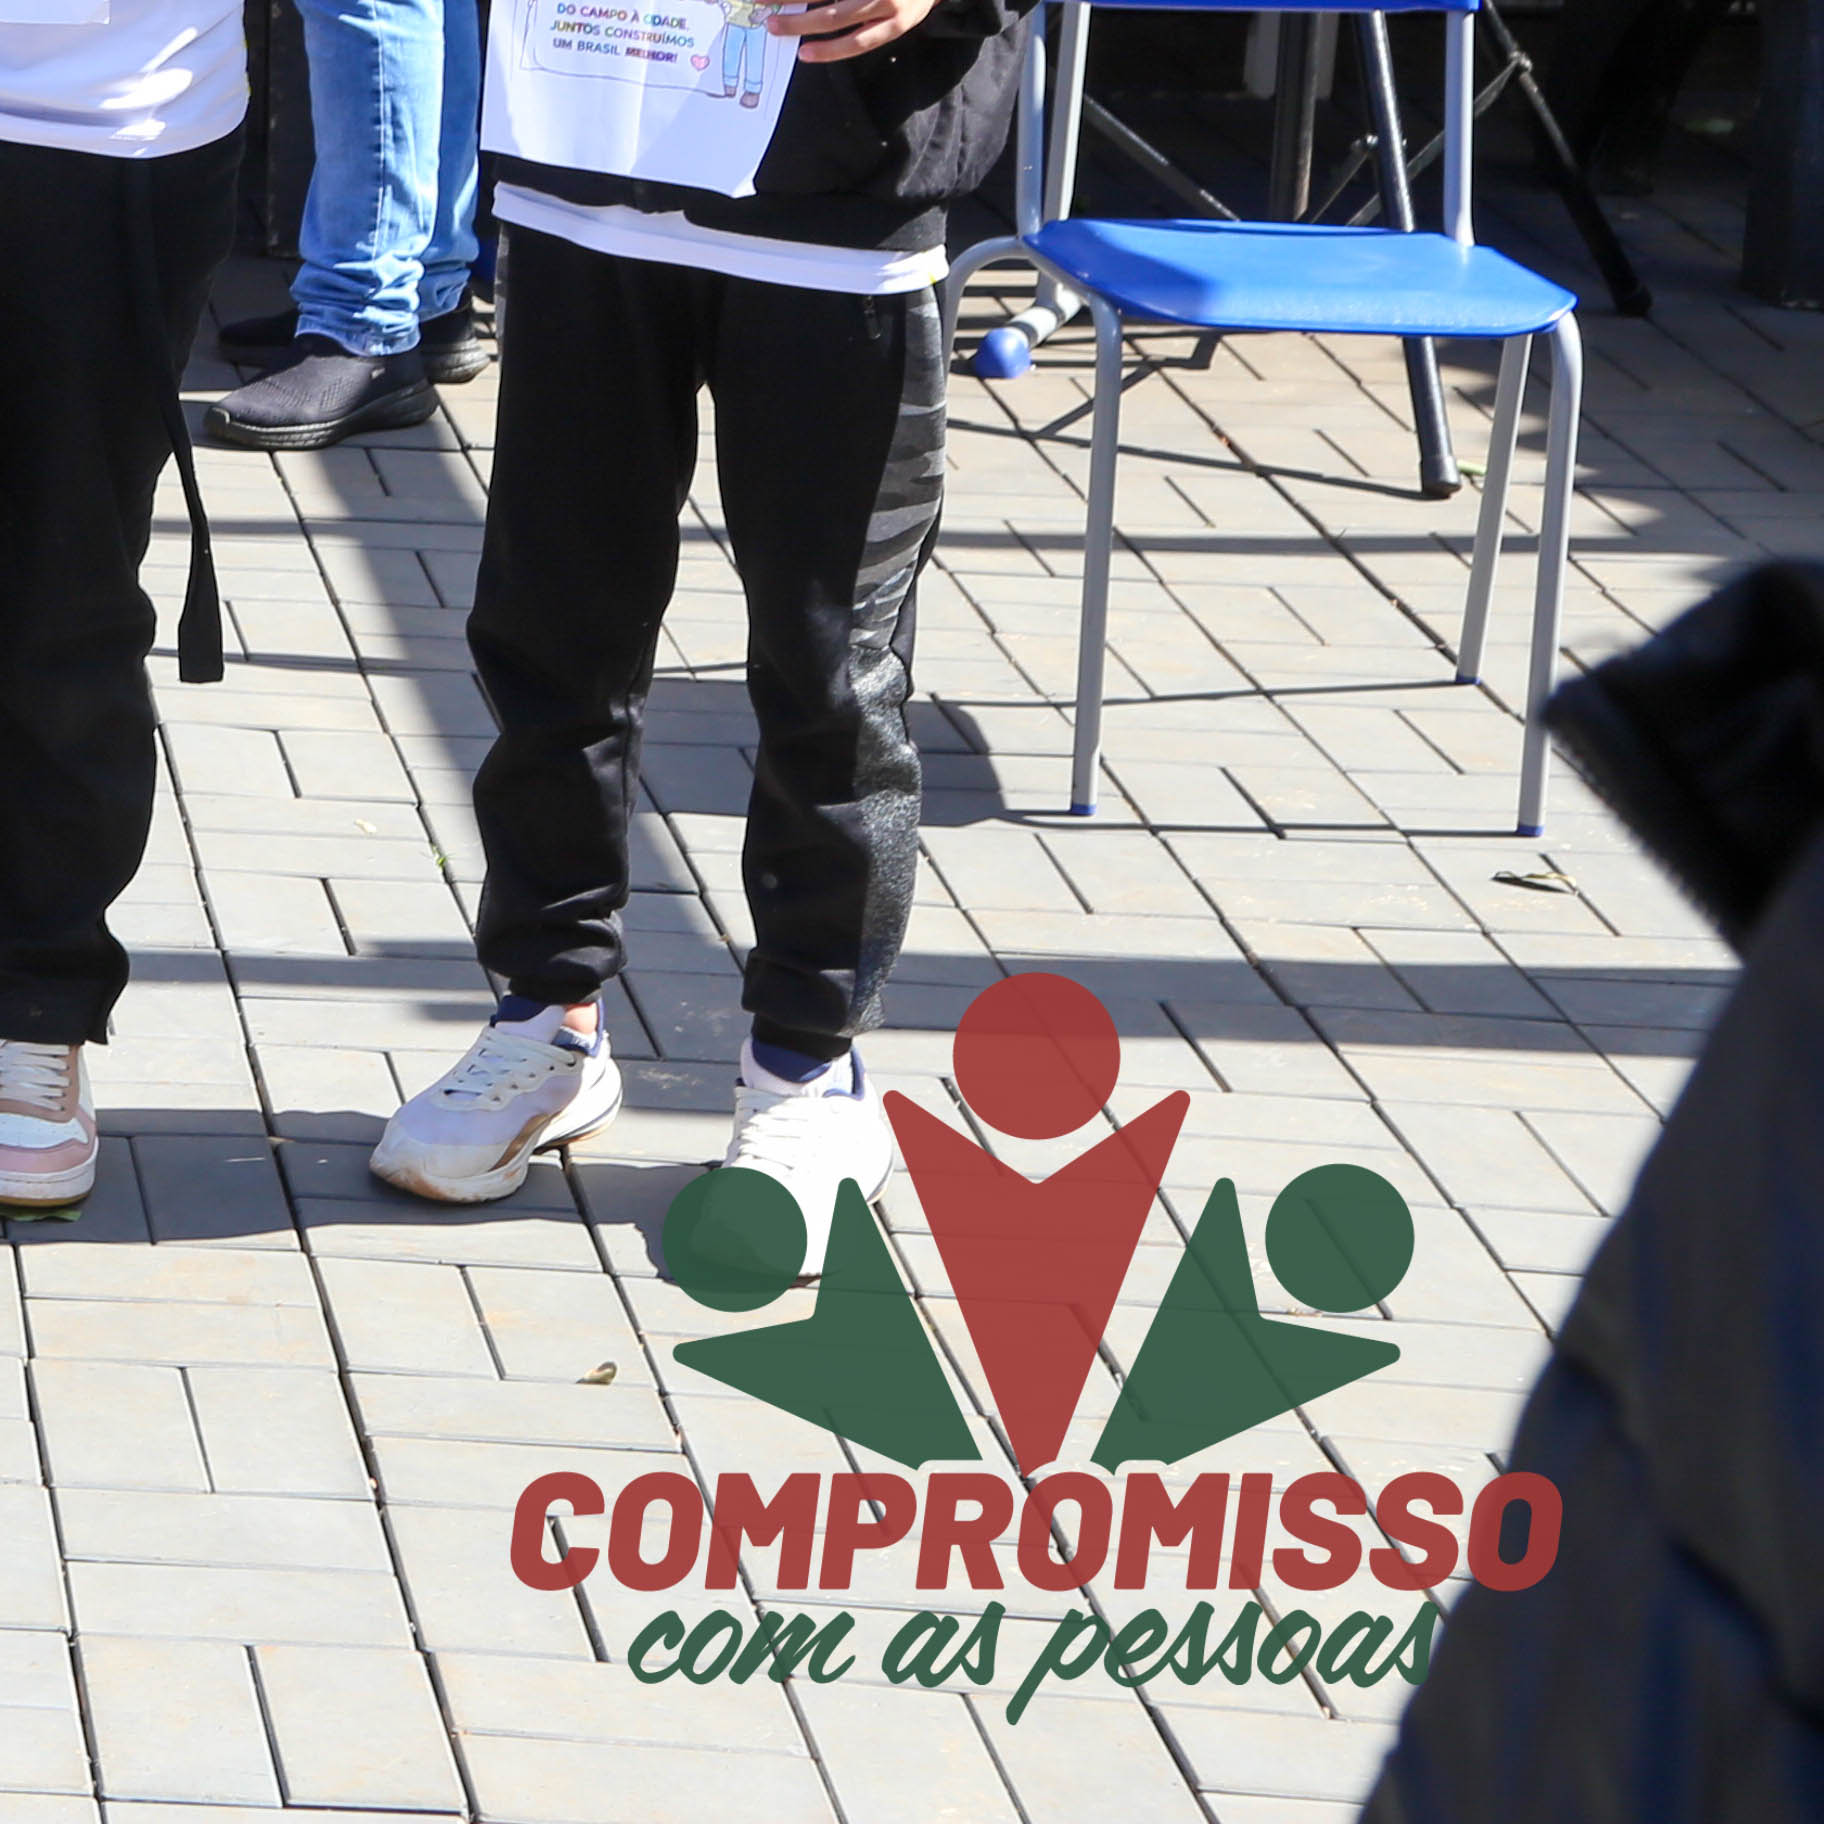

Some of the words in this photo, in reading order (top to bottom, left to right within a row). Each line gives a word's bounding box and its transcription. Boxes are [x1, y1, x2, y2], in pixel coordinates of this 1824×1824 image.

[556, 2, 577, 16] DO
[580, 5, 628, 22] CAMPO
[631, 8, 640, 23] À
[550, 19, 601, 36] JUNTOS
[604, 26, 694, 48] CONSTRUÍMOS
[553, 37, 573, 50] UM
[577, 40, 621, 56] BRASIL
[625, 46, 678, 64] MELHOR!
